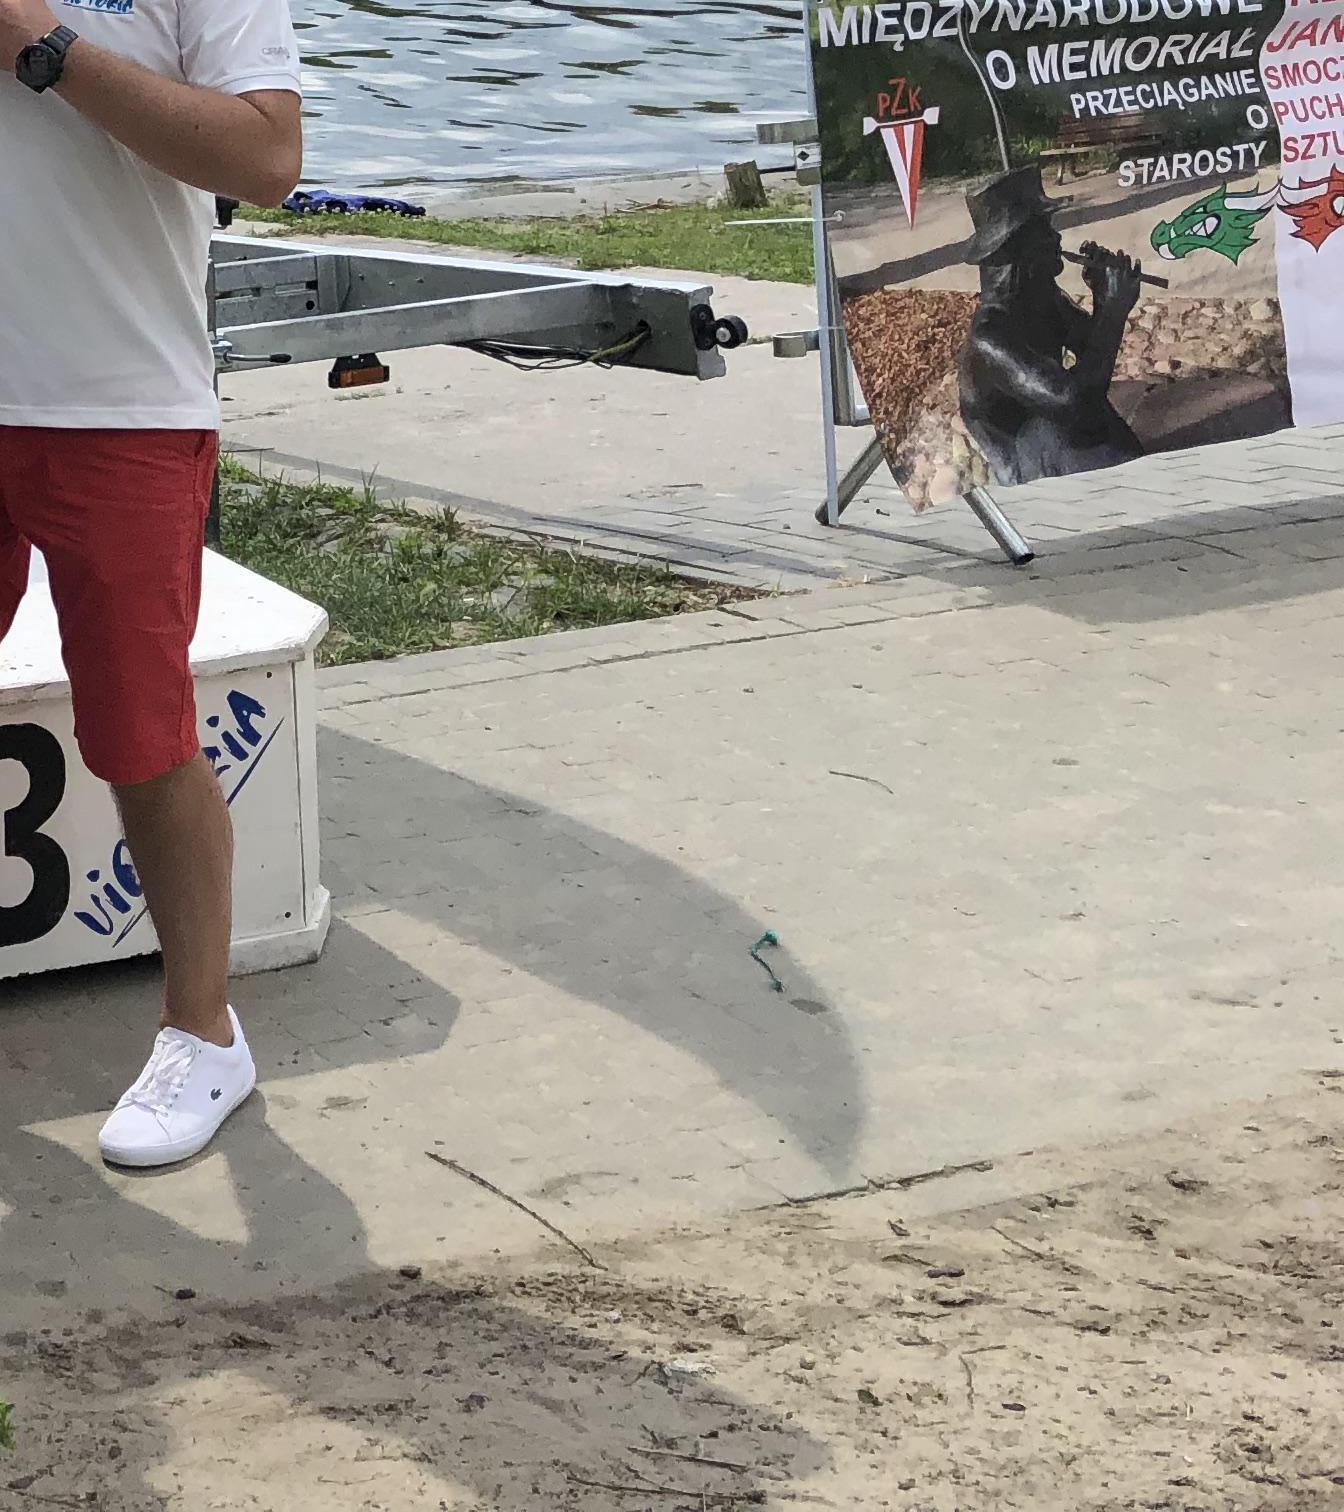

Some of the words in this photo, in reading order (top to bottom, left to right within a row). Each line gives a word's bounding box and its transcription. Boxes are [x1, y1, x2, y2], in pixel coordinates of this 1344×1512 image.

[986, 50, 1017, 90] O
[1027, 27, 1255, 86] MEMORIAŁ
[877, 78, 921, 117] PZK
[1070, 68, 1261, 119] PRZECIĄGANIE
[1246, 104, 1269, 130] O
[1118, 141, 1268, 188] STAROSTY
